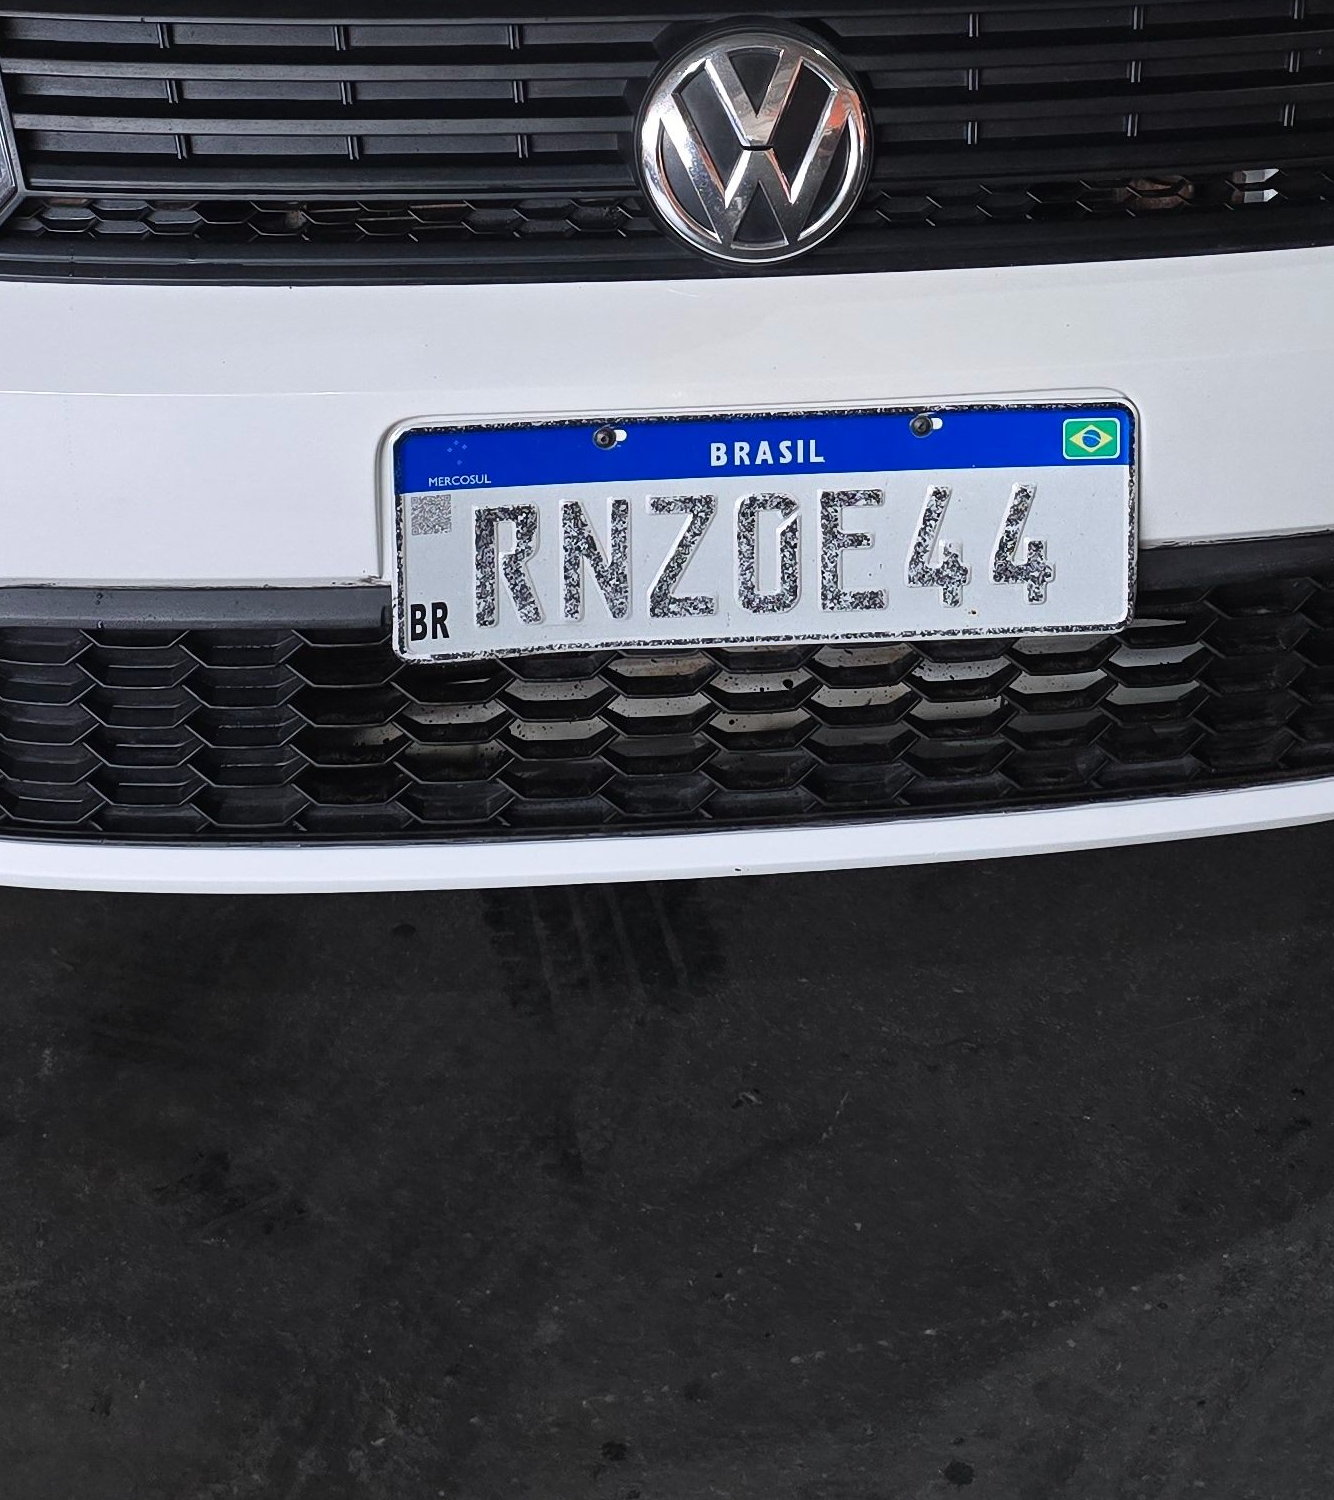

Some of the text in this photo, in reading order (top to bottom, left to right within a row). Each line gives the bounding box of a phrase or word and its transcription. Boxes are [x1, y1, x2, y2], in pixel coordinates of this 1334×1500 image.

[710, 439, 826, 467] BRASIL
[428, 474, 492, 487] MERCOSUL
[410, 601, 450, 643] BR
